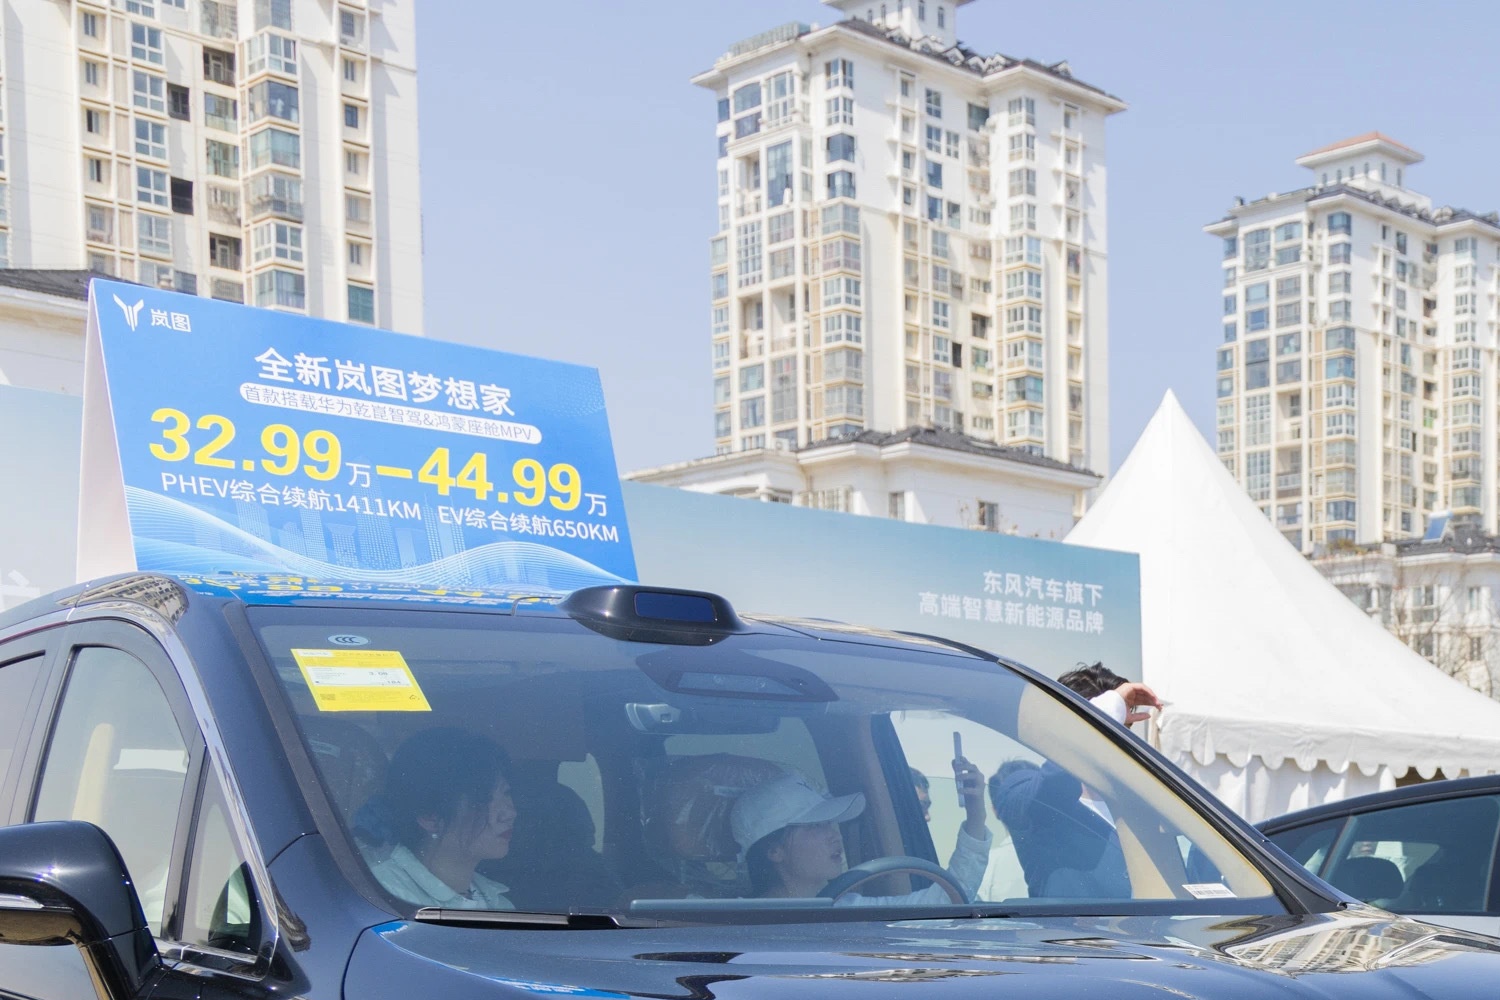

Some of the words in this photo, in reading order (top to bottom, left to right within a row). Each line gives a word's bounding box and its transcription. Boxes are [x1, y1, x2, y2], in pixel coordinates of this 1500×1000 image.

[150, 308, 191, 333] 岚图
[254, 346, 516, 416] 全新岚图梦想家
[161, 472, 422, 521] PHEV综合续航1411KM
[438, 508, 619, 542] EV综合续航650KM
[983, 570, 1103, 607] 东风汽车旗下
[918, 591, 1104, 634] 高端智慧新能源品牌
